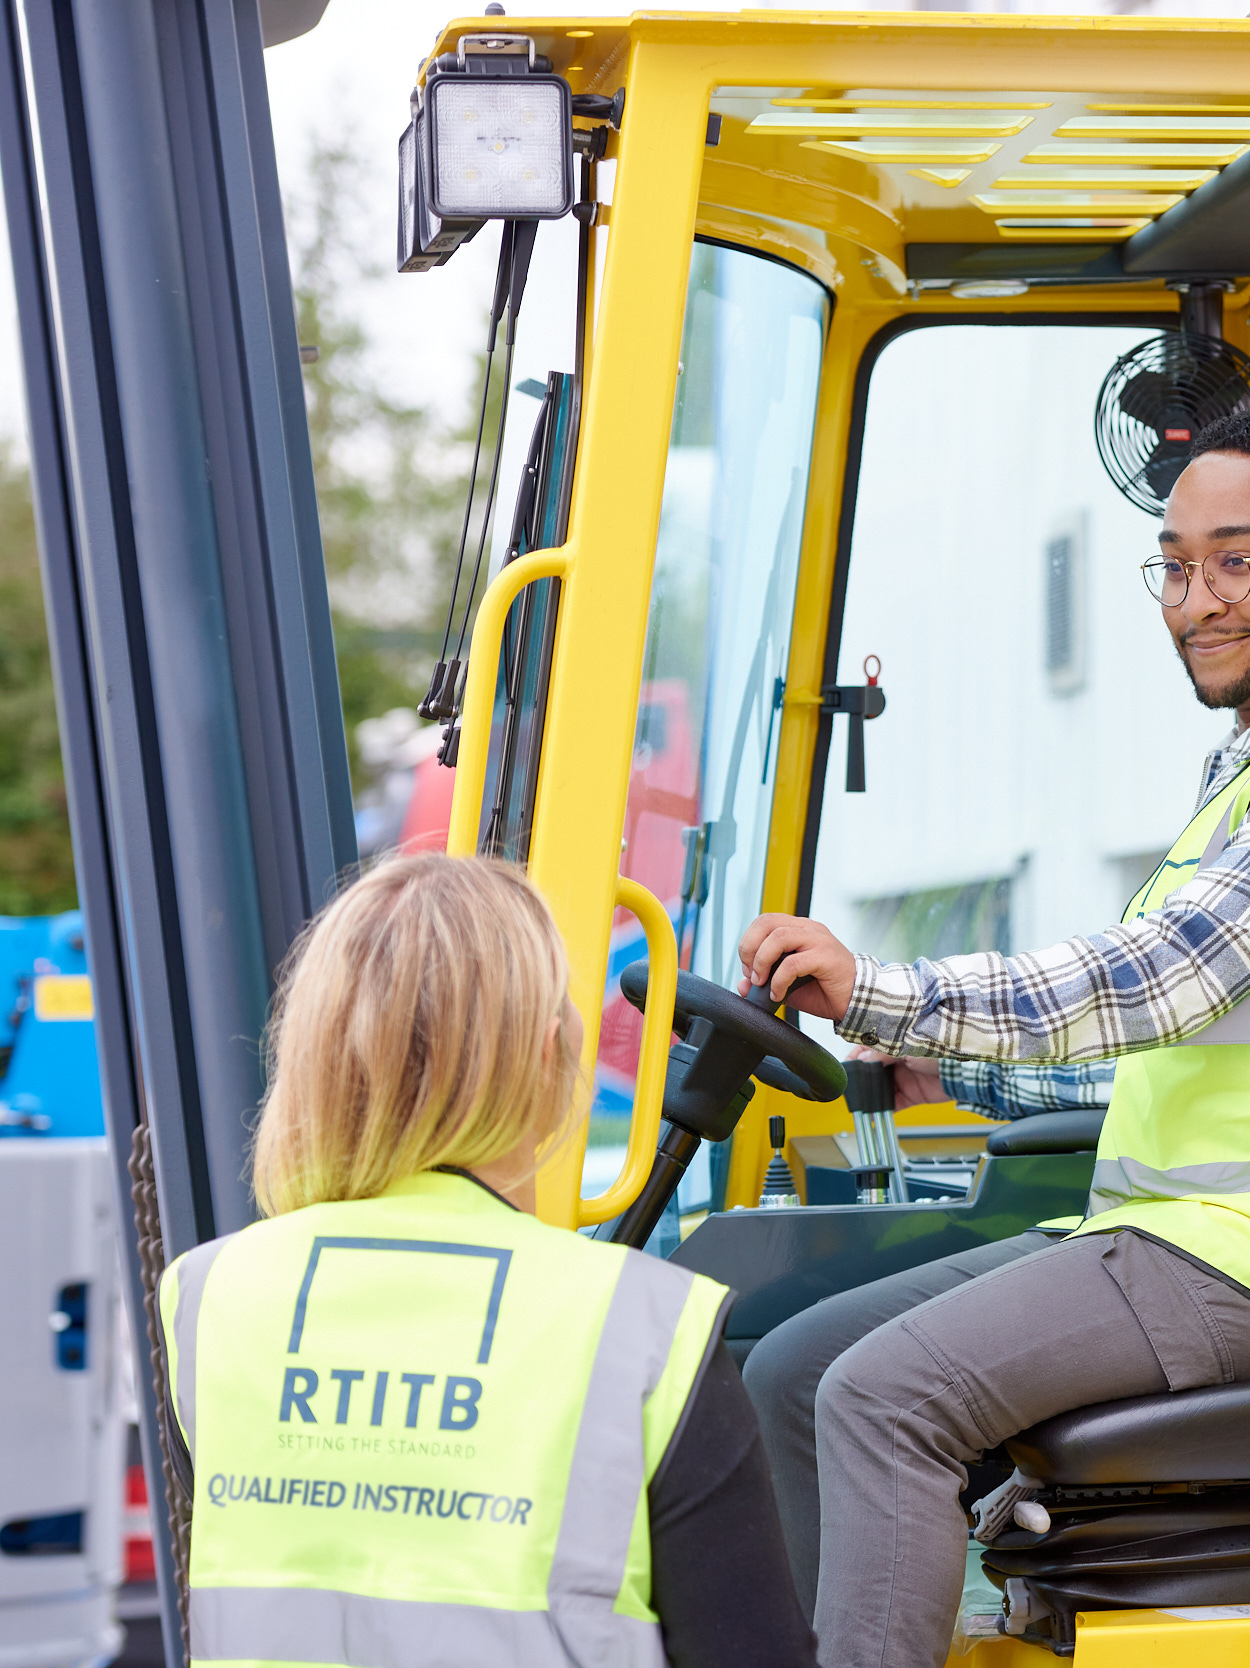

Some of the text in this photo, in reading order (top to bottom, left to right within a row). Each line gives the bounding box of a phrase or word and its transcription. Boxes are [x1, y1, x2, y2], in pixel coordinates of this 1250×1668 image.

[279, 1367, 483, 1431] RTITB
[278, 1434, 476, 1459] SETTING THE STANDARD
[207, 1473, 533, 1526] QUALIFIED INSTRUCTOR
